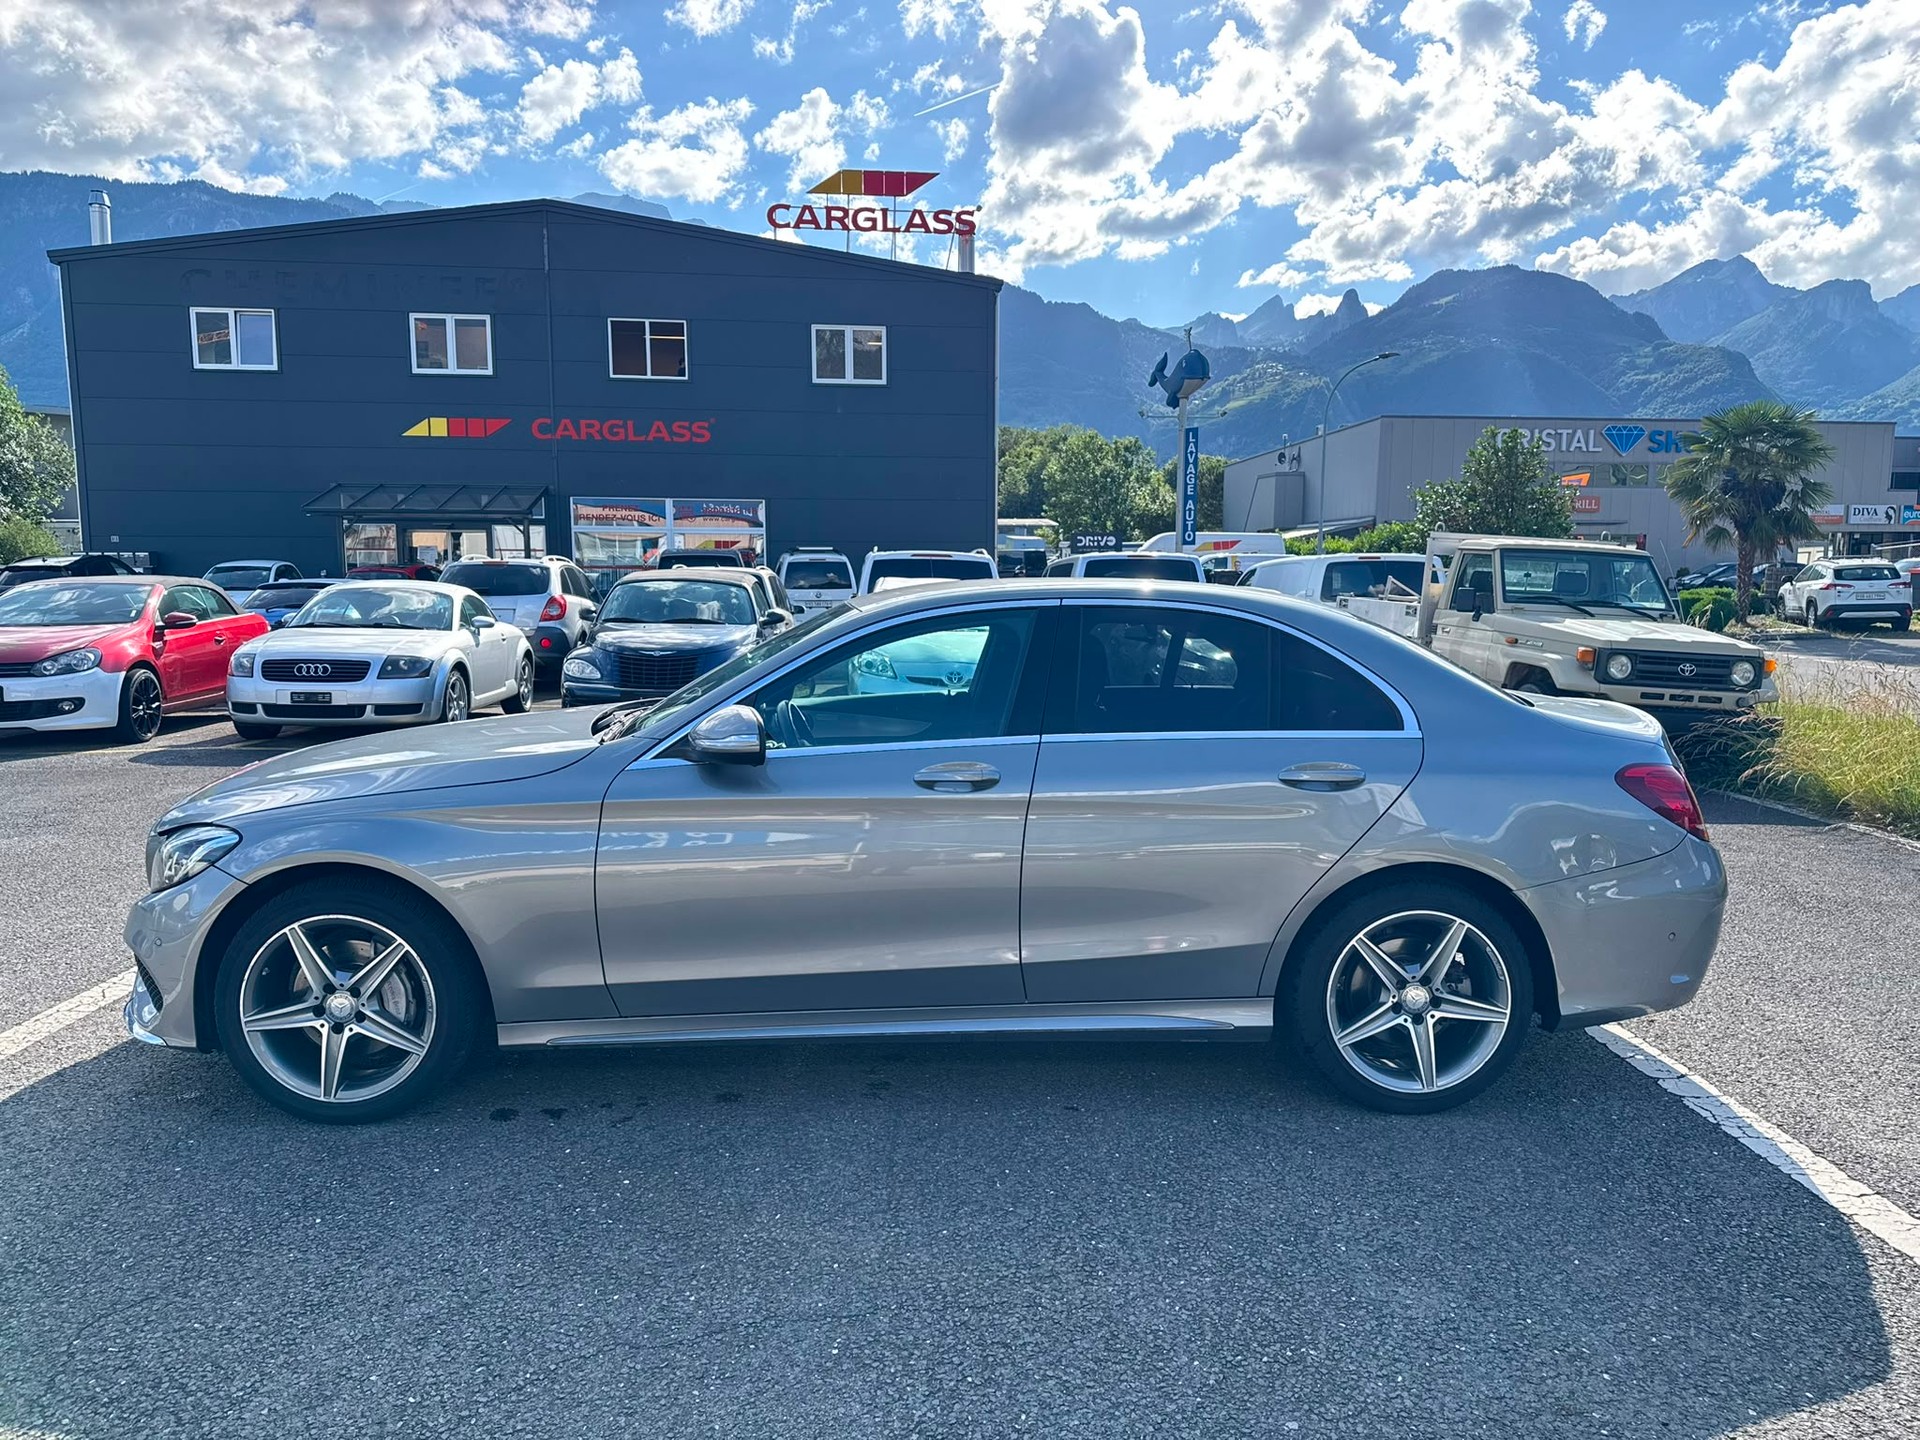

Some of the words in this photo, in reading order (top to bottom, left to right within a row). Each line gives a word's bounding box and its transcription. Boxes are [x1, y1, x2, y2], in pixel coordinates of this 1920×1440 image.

[766, 203, 977, 236] CARGLASS
[531, 417, 713, 443] CARGLASS
[1186, 431, 1196, 495] LAVAGE
[1574, 499, 1599, 509] RILL
[1853, 507, 1878, 516] DIVA
[580, 513, 646, 522] RENDEZ-VOUS
[649, 514, 661, 522] ICI
[1185, 500, 1195, 541] AUTO
